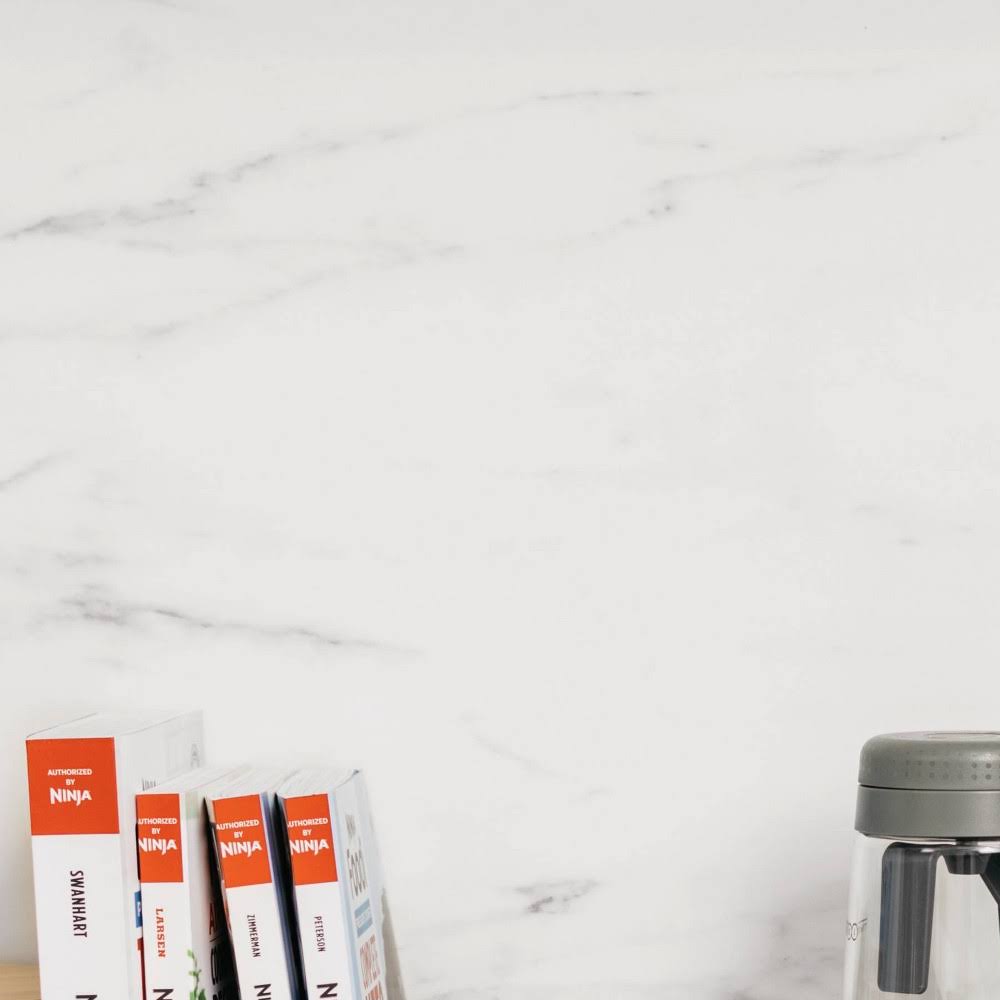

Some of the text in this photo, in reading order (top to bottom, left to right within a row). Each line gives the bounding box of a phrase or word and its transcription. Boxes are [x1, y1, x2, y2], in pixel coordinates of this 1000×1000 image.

[48, 768, 92, 776] AUTHORIZED
[50, 787, 92, 806] NINJA
[220, 841, 262, 858] NINJA
[290, 839, 329, 855] NINJA
[70, 870, 87, 937] SWANHART
[156, 908, 166, 957] LARSEN
[247, 915, 261, 957] ZIMMERMAN
[314, 916, 326, 952] PETERSON
